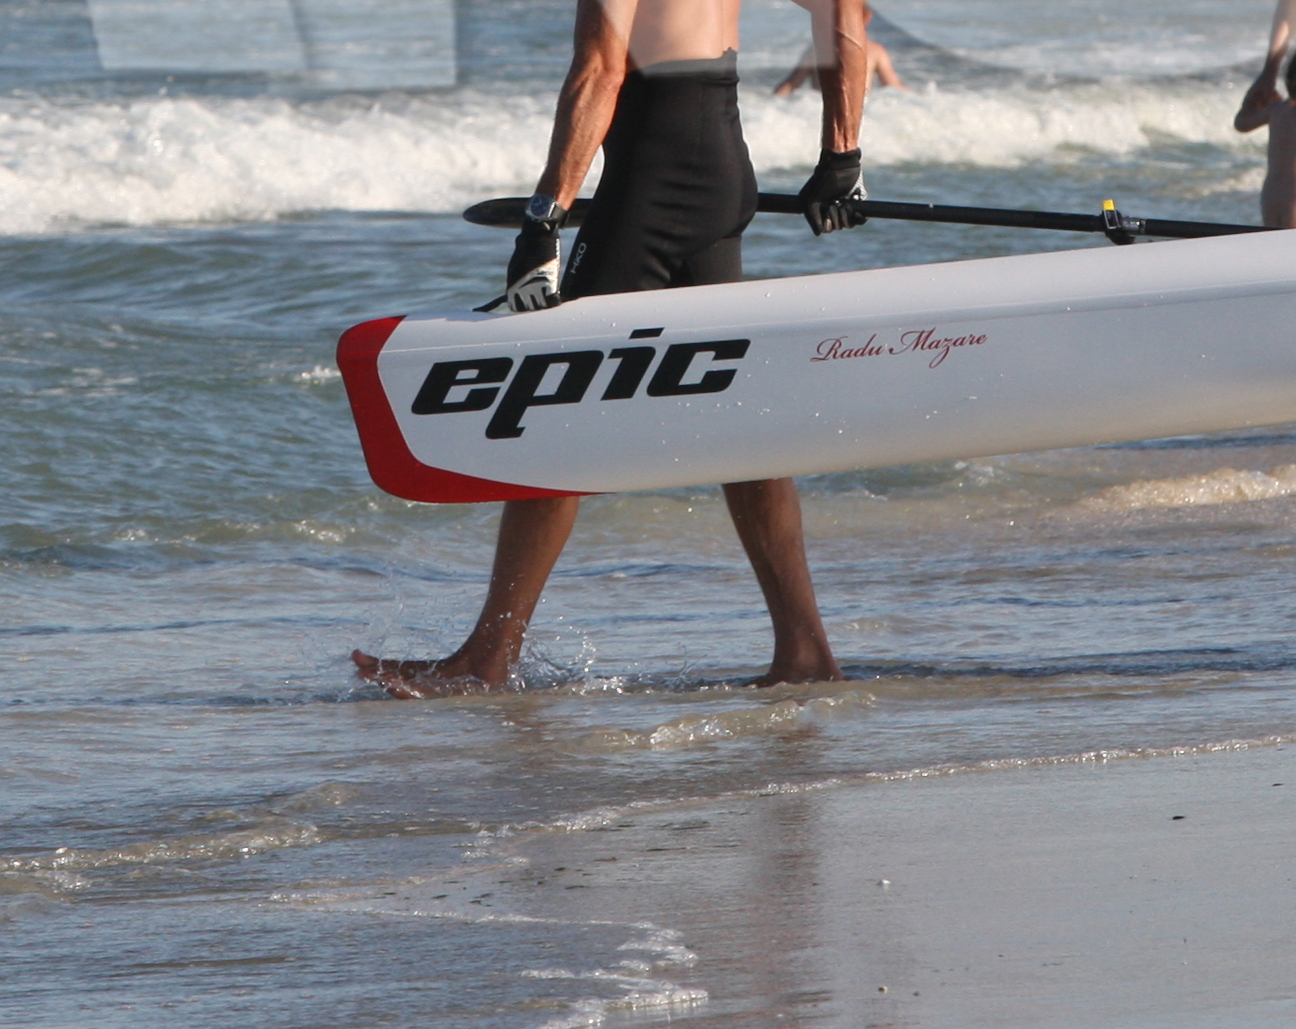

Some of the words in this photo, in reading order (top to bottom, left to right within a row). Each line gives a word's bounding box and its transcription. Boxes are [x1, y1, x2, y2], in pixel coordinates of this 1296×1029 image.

[411, 327, 751, 440] epic
[810, 333, 883, 363] Radu
[889, 327, 988, 369] Mazare
